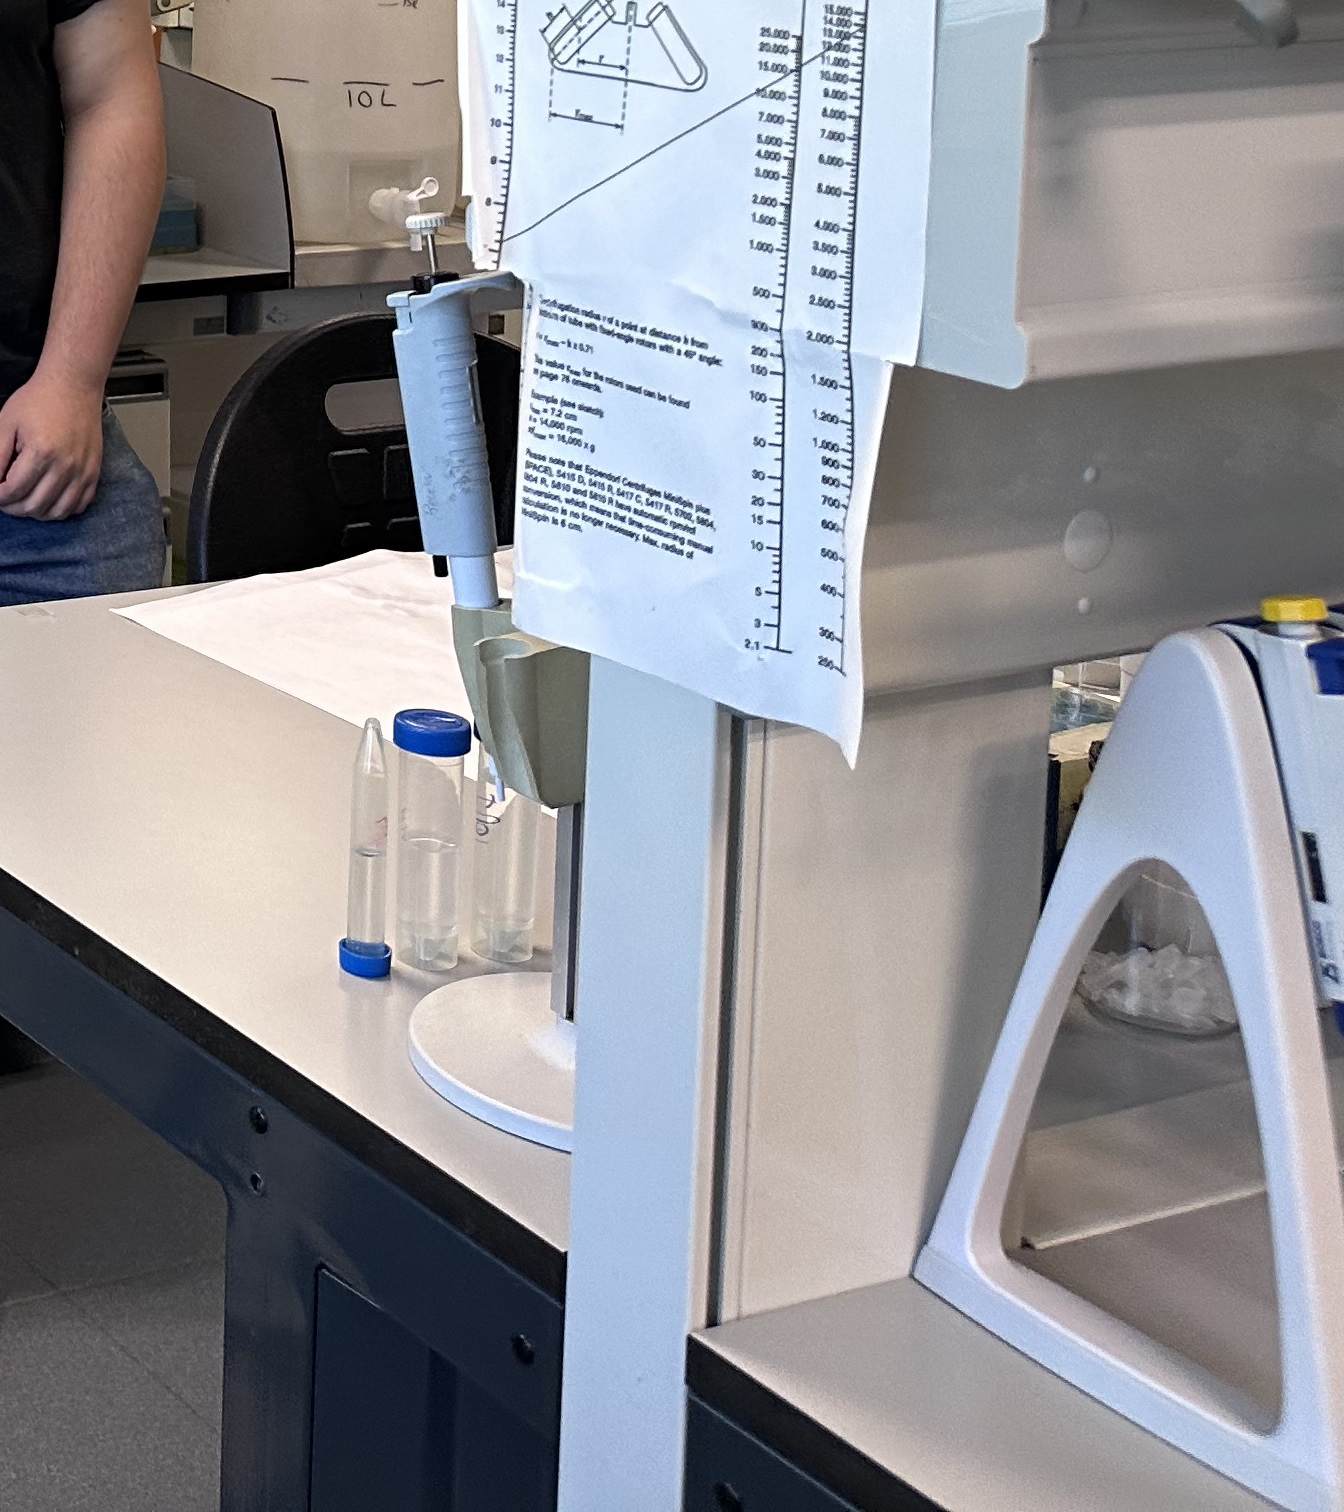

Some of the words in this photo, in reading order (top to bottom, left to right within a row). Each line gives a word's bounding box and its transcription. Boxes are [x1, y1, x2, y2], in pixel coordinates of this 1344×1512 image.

[490, 118, 501, 128] 10
[807, 331, 834, 345] 2.000
[750, 390, 767, 403] 100
[753, 436, 766, 448] 50
[752, 469, 765, 480] 30
[751, 495, 764, 507] 20
[821, 495, 840, 509] 700
[751, 514, 763, 525] 15
[751, 540, 763, 551] 10
